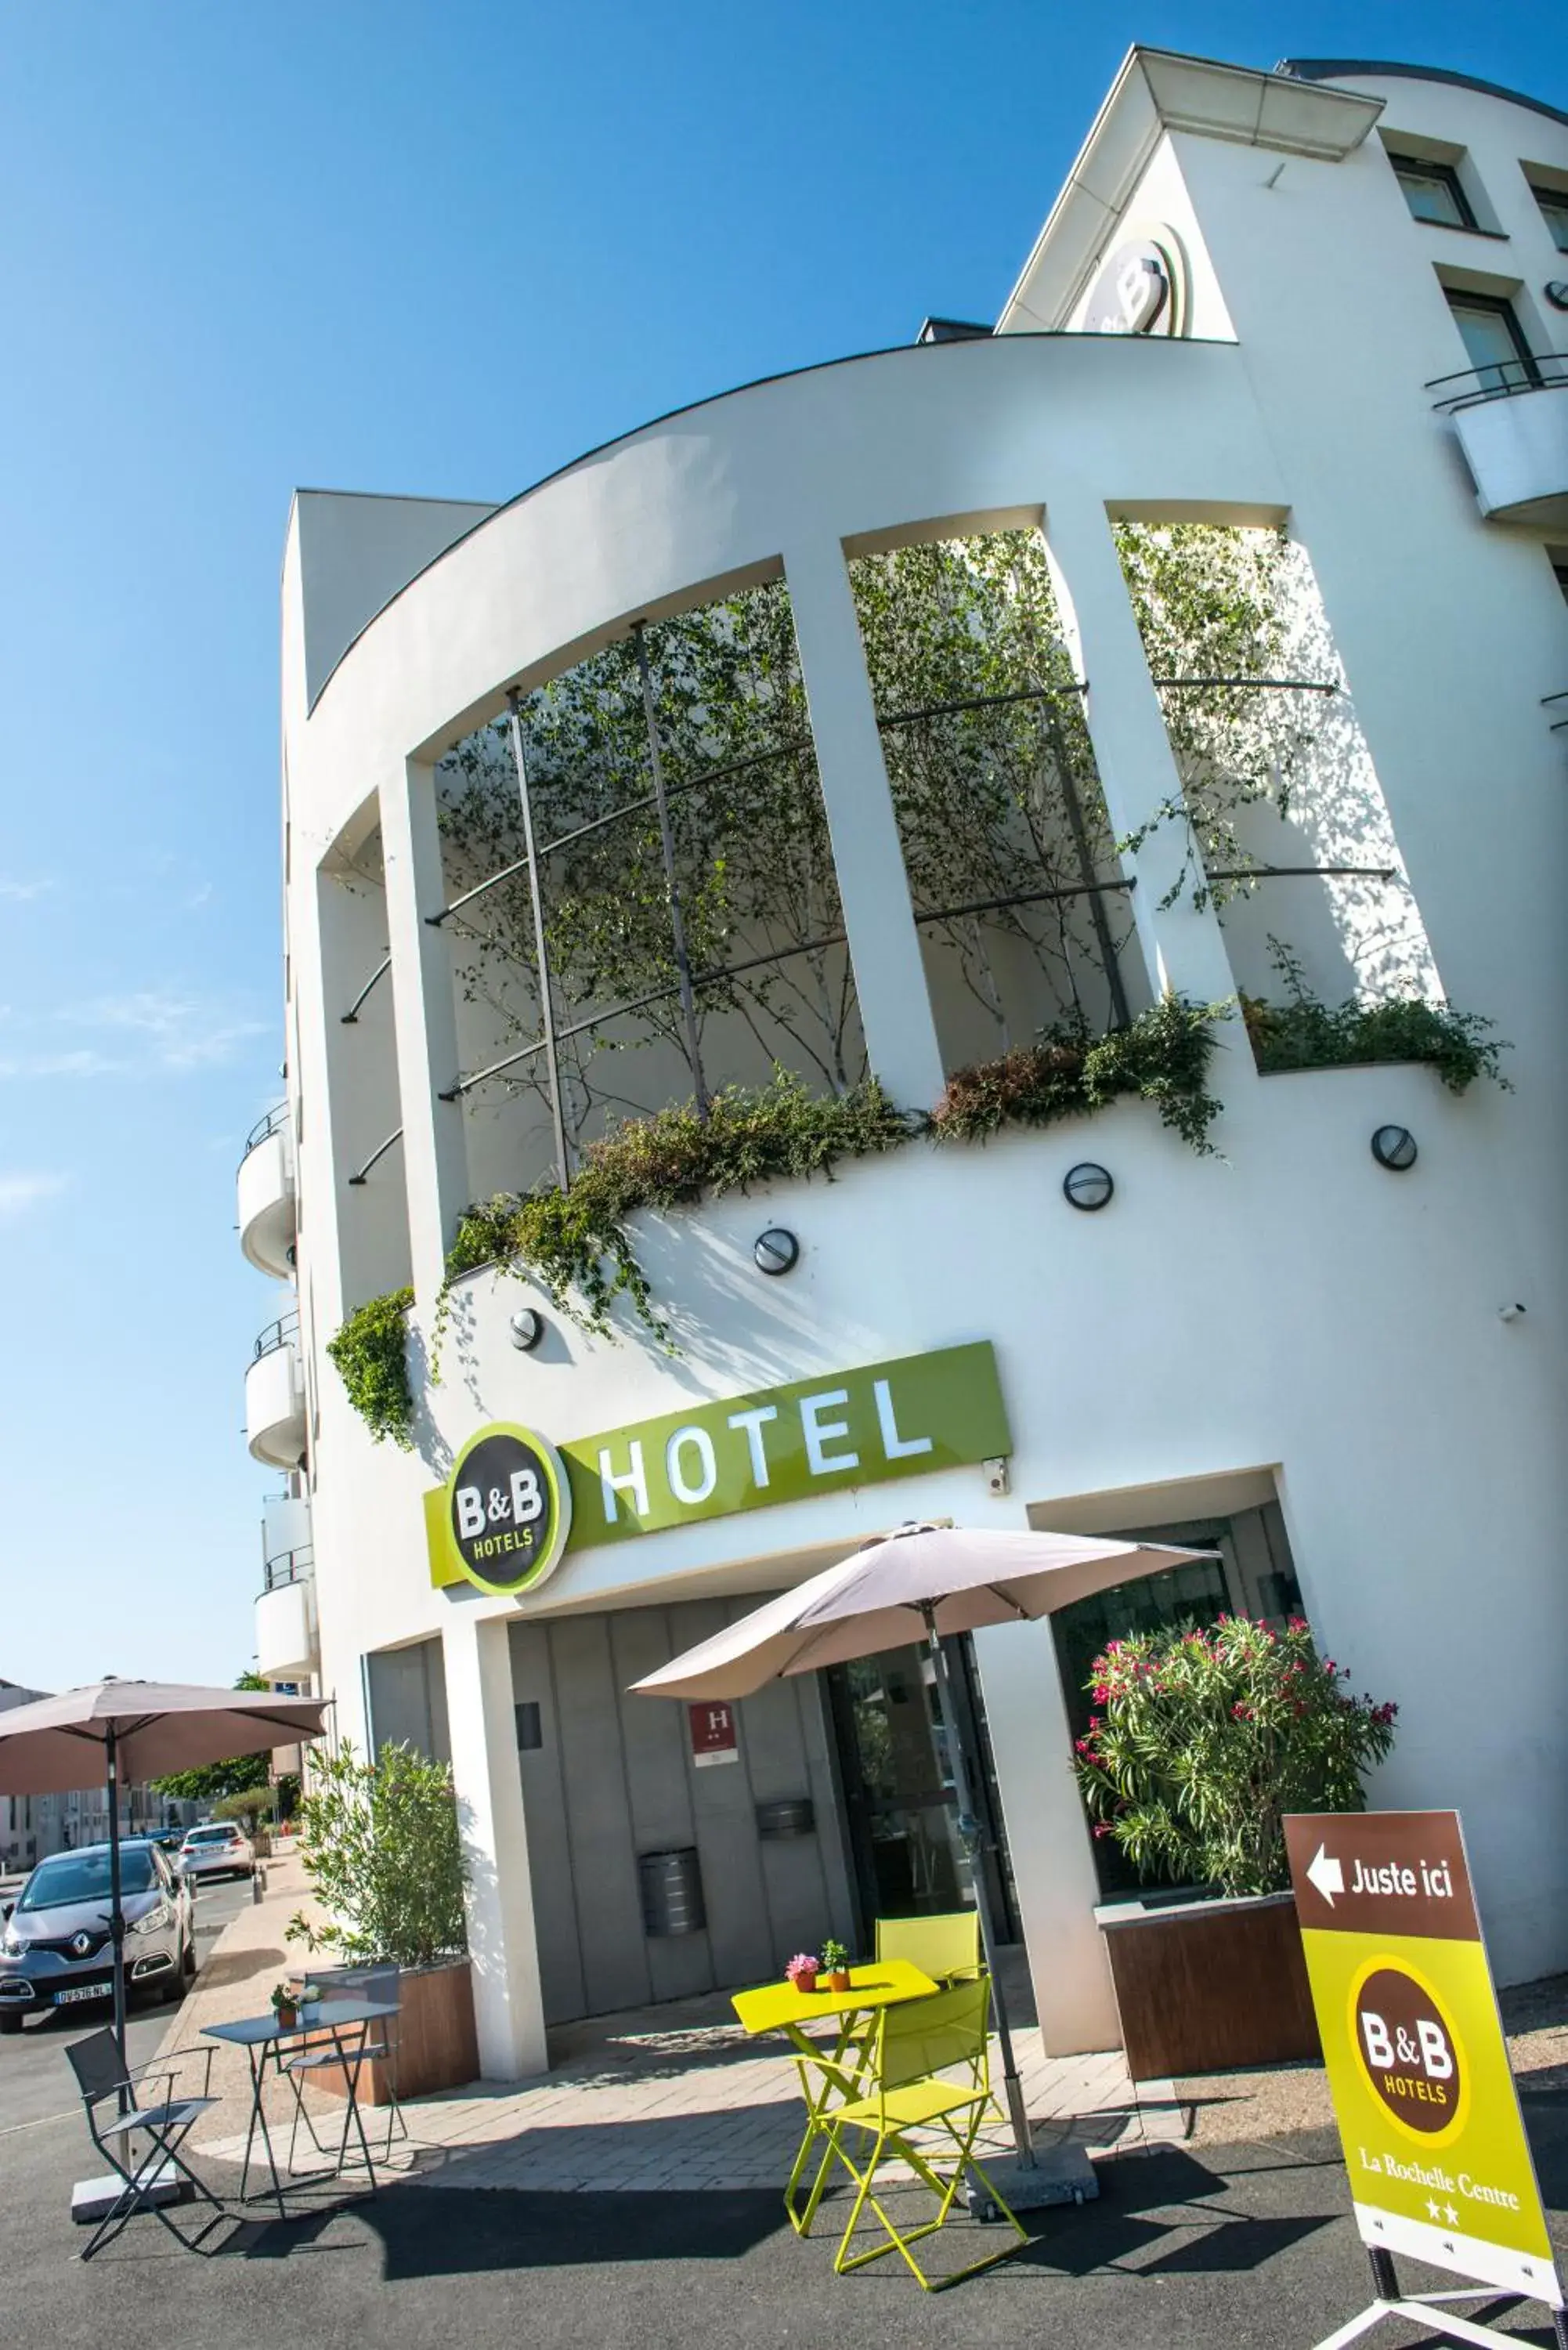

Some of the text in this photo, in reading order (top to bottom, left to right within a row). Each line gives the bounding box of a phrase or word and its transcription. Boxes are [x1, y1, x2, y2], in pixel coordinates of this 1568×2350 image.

[598, 1379, 933, 1524] HOTEL
[457, 1469, 542, 1540] B&B
[473, 1528, 533, 1560] HOTELS
[709, 1710, 729, 1730] H
[1352, 1859, 1454, 1897] Juste ici
[1361, 2012, 1453, 2079] B&B
[1384, 2074, 1447, 2104] HOTELS
[1358, 2146, 1520, 2211] La Rochelle Centre
